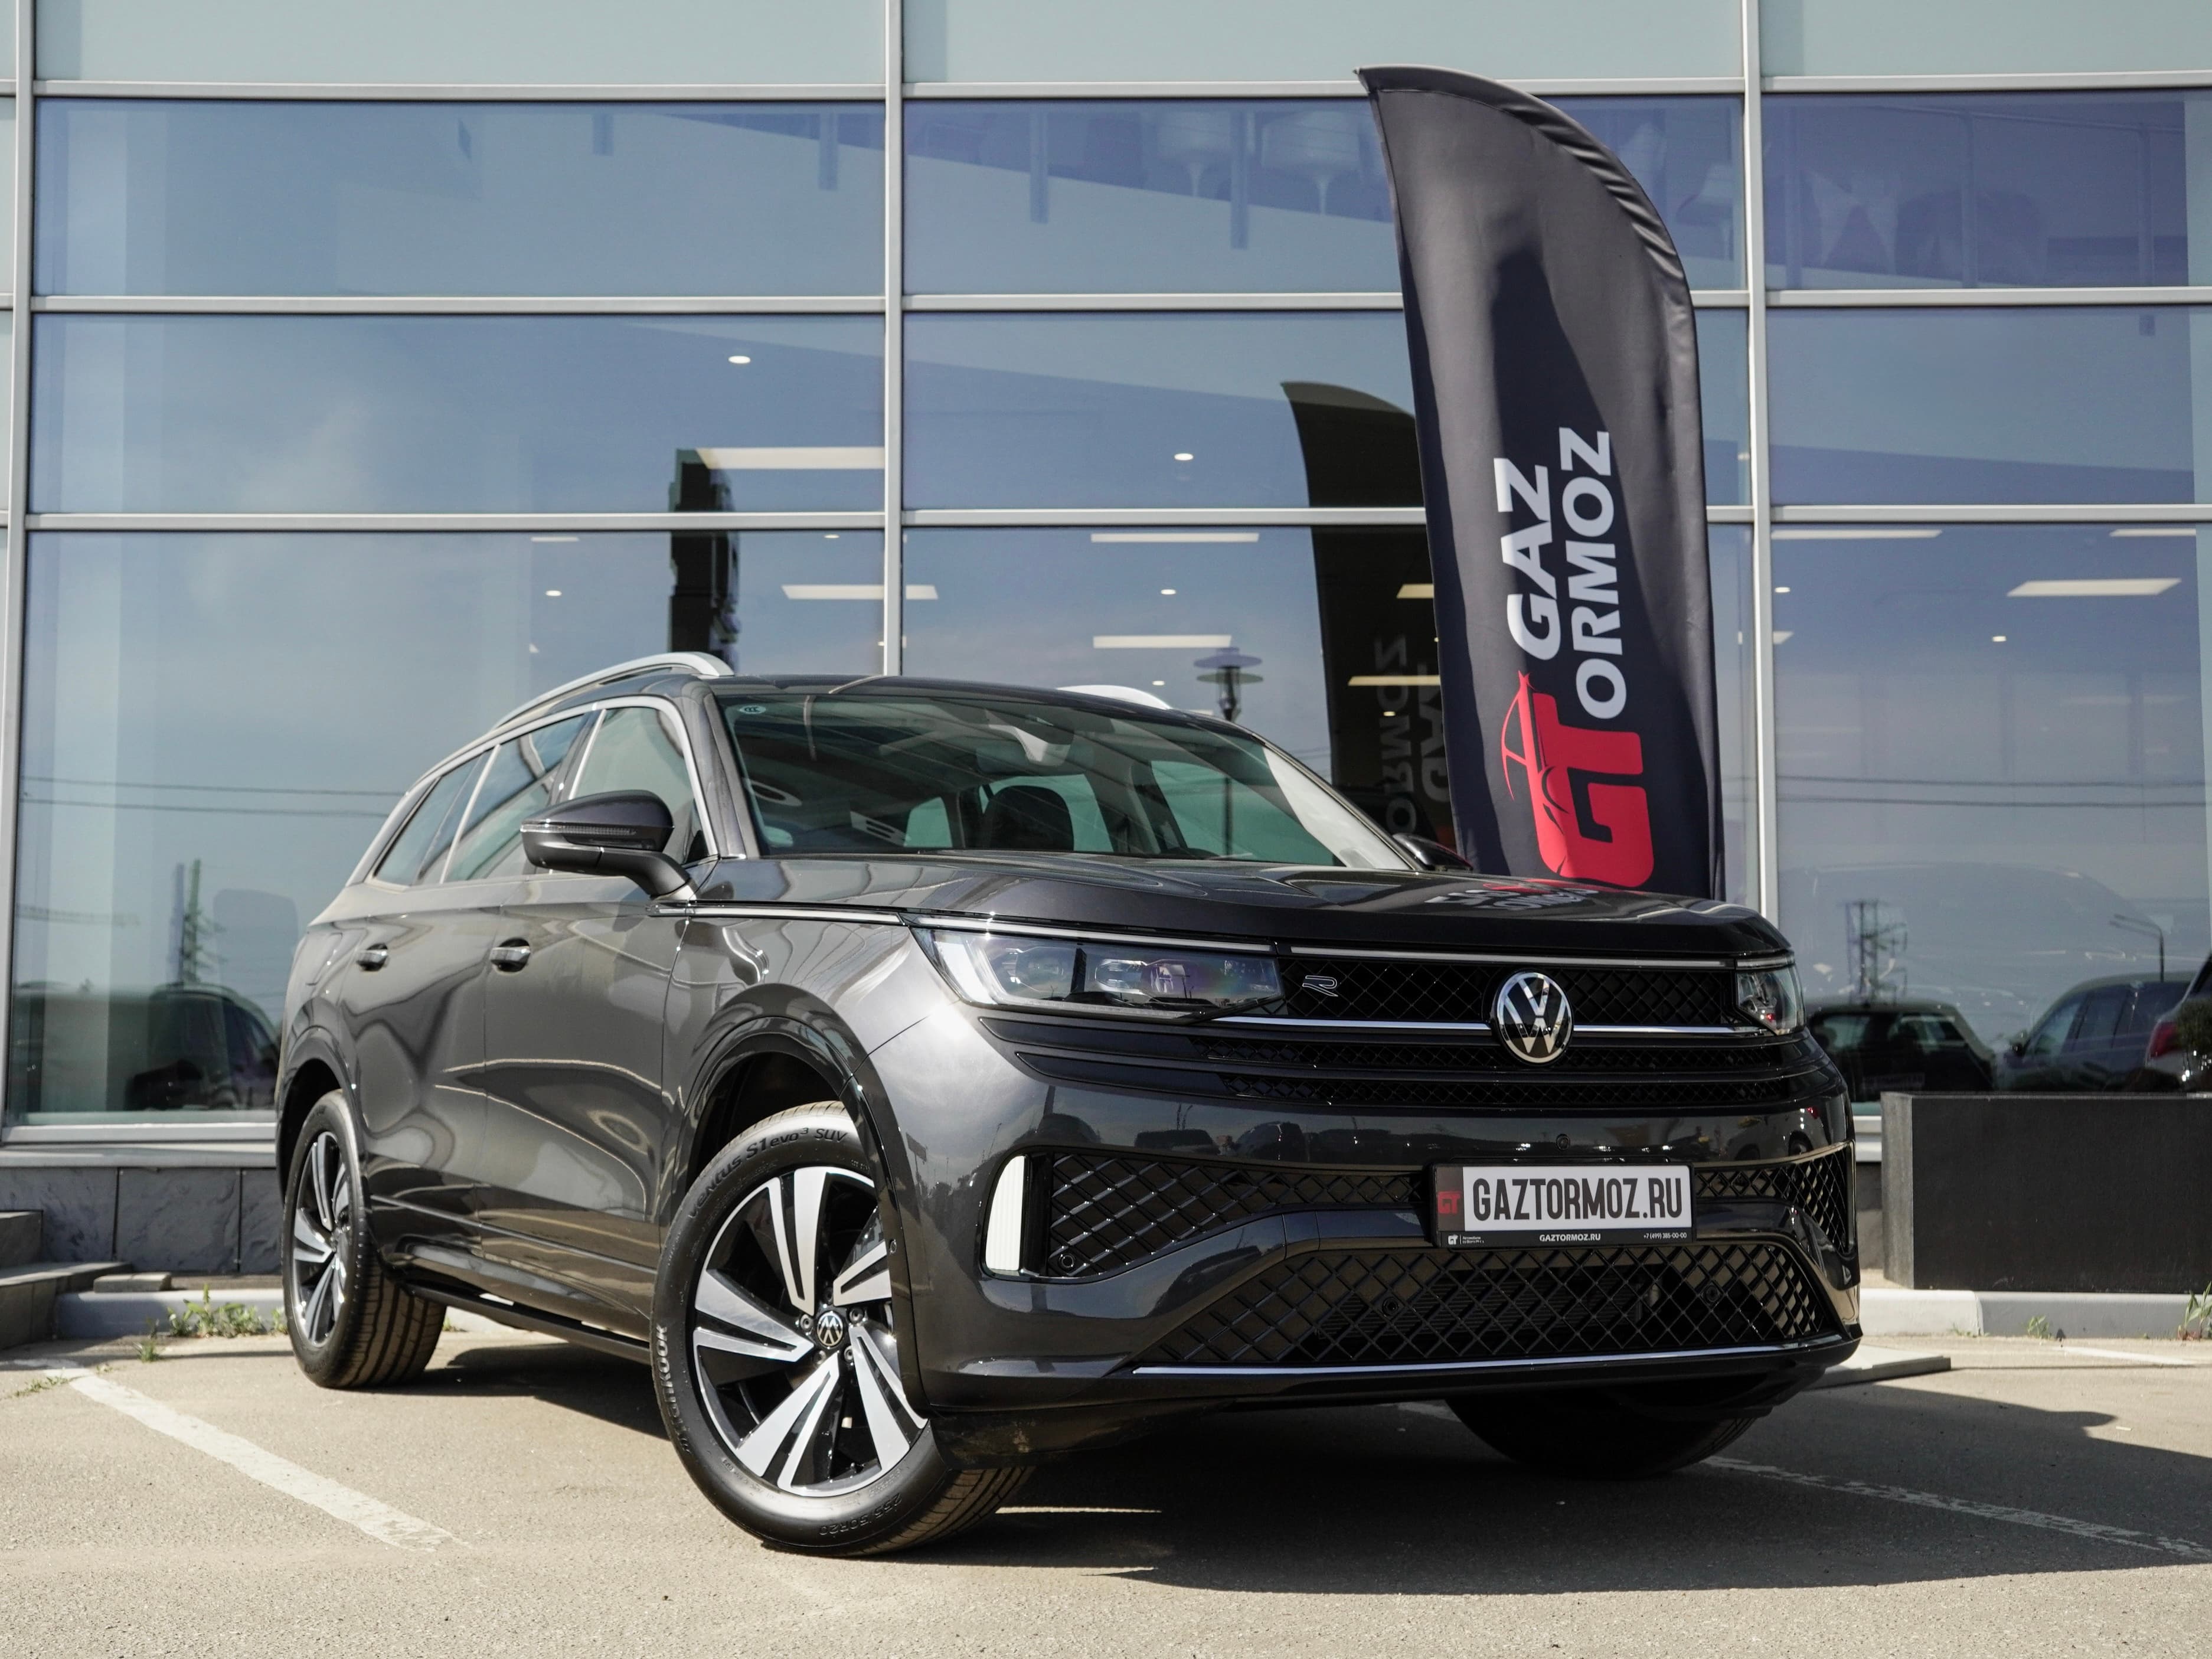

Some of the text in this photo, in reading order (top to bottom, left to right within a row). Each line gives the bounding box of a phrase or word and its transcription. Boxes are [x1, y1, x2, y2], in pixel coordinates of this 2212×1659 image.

[1494, 458, 1561, 660] GAZ
[1559, 427, 1627, 719] ORMOZ
[814, 1128, 848, 1142] SUV
[1473, 1178, 1682, 1221] GAZTORMOZ.RU
[1539, 1233, 1601, 1242] GAZTORMOZ.RU
